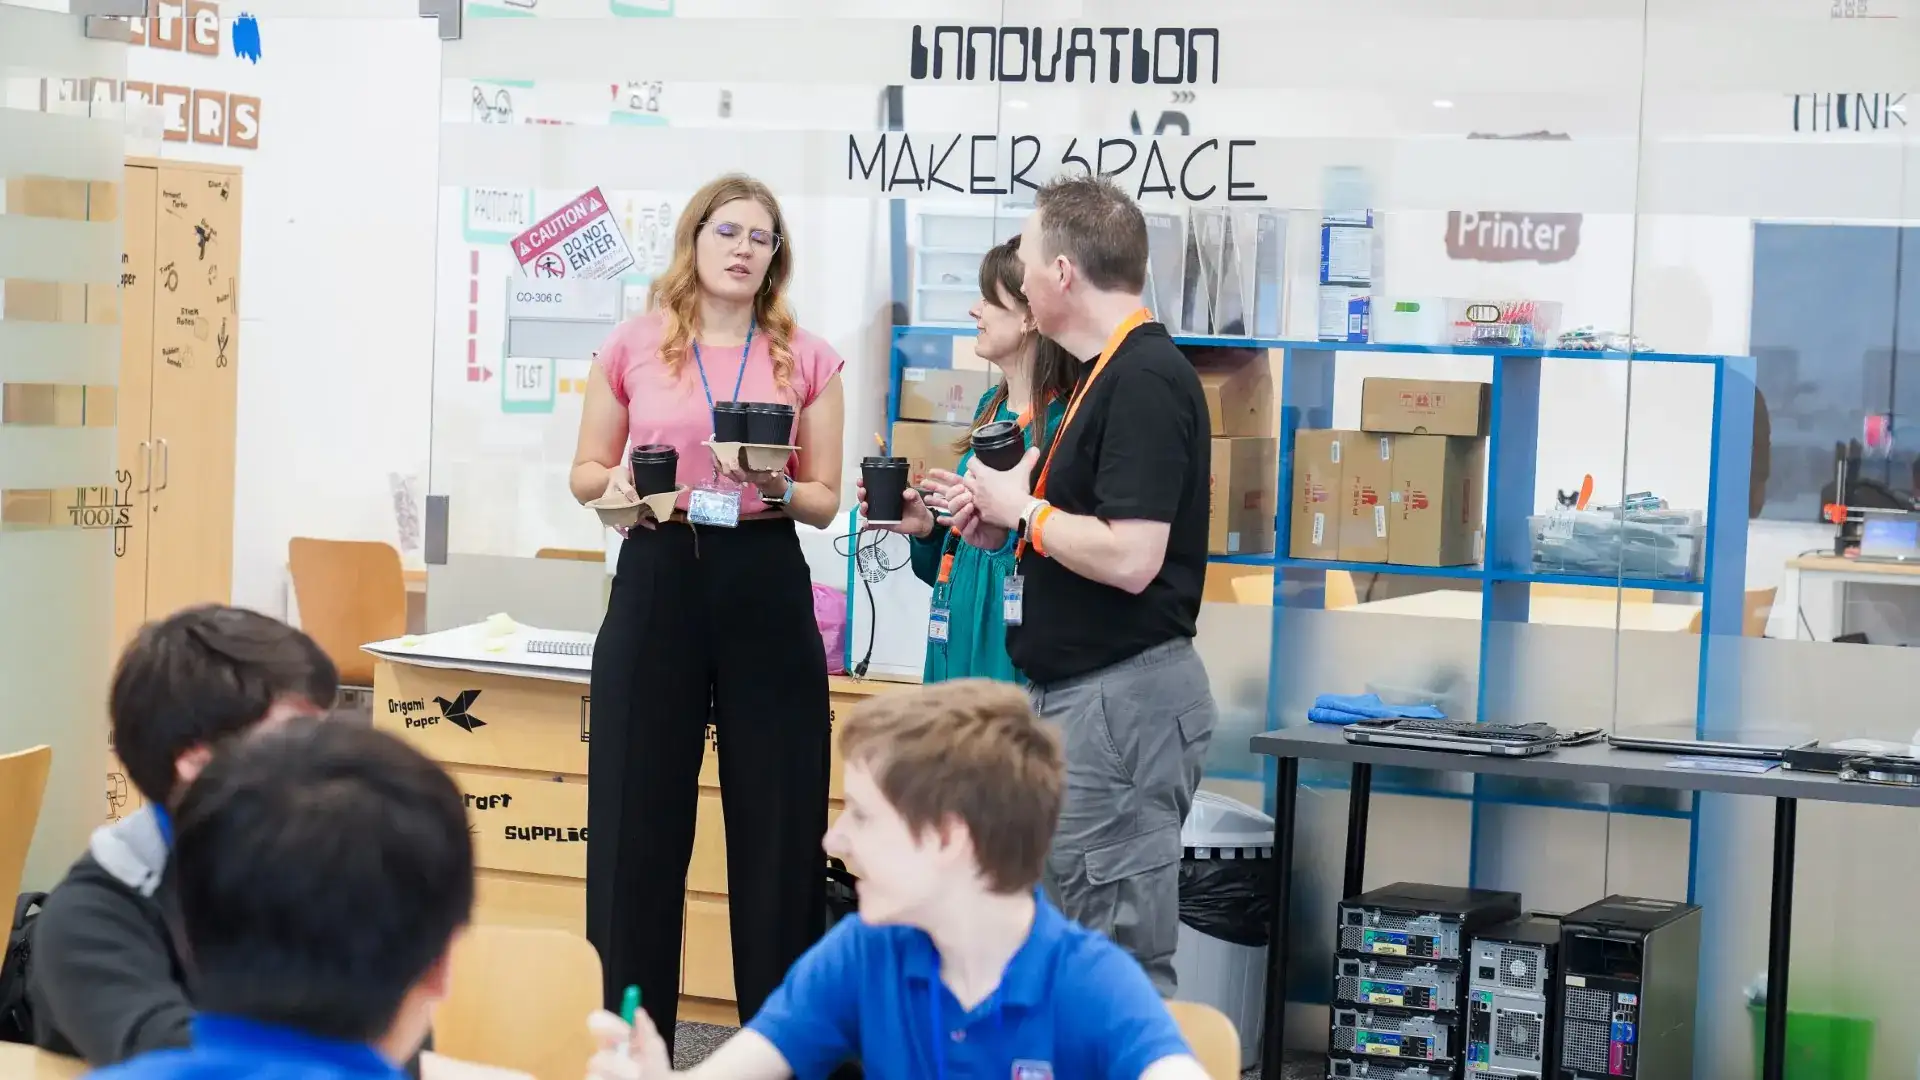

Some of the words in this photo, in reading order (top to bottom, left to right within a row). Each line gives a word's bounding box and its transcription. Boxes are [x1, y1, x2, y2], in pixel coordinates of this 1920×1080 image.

[910, 24, 1220, 84] INNOVATION
[1784, 92, 1908, 132] THINK
[848, 133, 1042, 195] MAKER
[1061, 137, 1268, 201] SPACE
[529, 203, 588, 248] CAUTION
[563, 237, 582, 256] DO
[582, 220, 610, 244] NOT
[1458, 210, 1567, 251] Printer
[569, 233, 616, 271] ENTER
[516, 292, 552, 303] CO-306
[554, 293, 563, 303] C
[69, 508, 130, 526] TOOLS
[388, 697, 425, 715] Origami
[405, 715, 441, 729] Paper
[464, 793, 513, 811] raft
